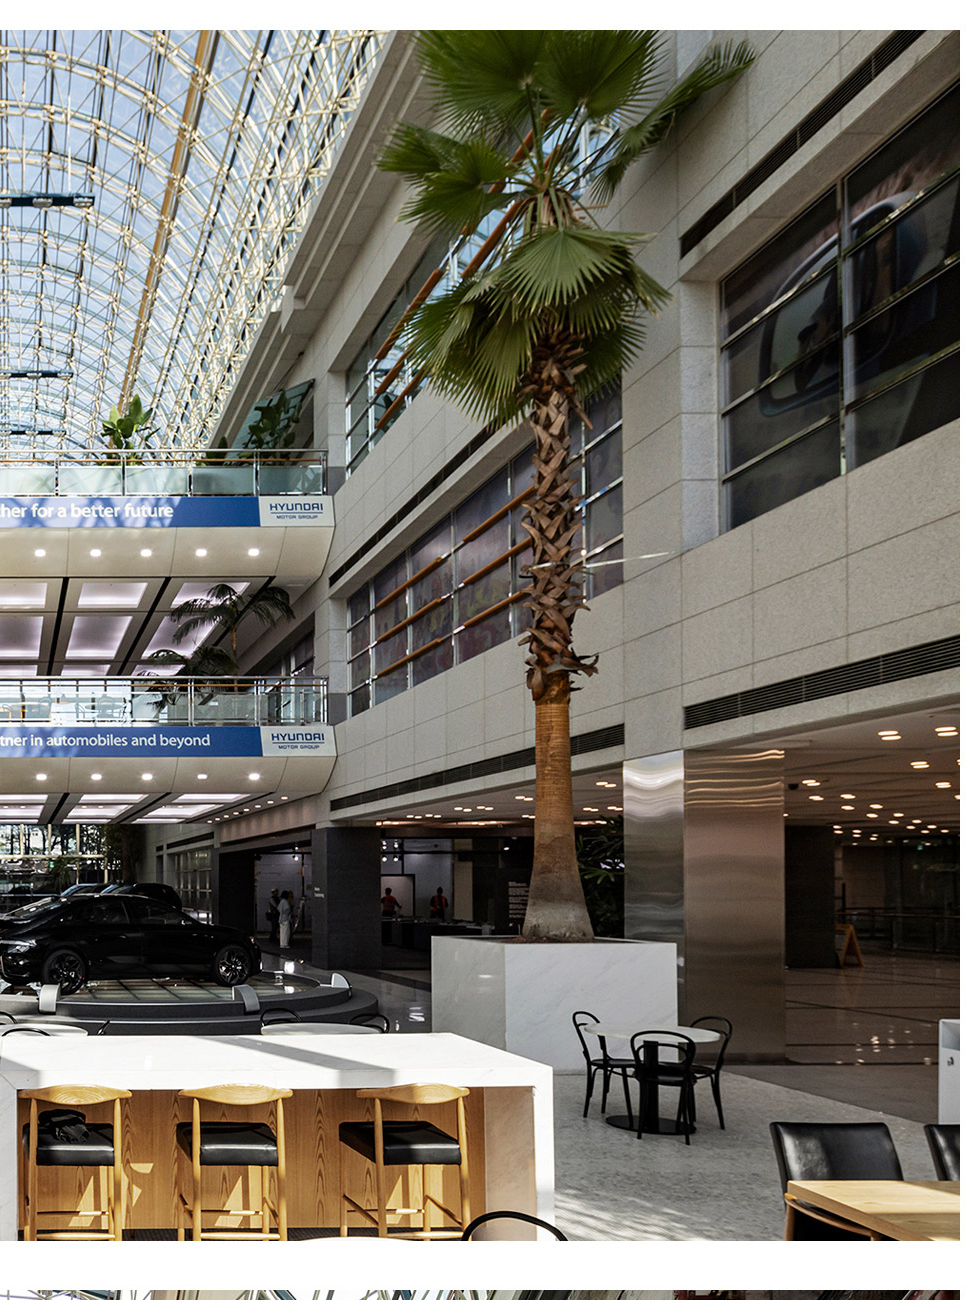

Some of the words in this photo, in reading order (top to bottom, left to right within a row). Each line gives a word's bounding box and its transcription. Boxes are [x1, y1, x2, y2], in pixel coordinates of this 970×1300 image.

[31, 503, 54, 518] for
[57, 508, 67, 518] a
[70, 503, 120, 518] better
[124, 503, 174, 518] future
[270, 503, 324, 511] HYUNDAI
[30, 733, 44, 747] in
[46, 732, 128, 747] automobiles
[131, 732, 157, 747] and
[160, 732, 211, 750] beyond
[271, 733, 325, 741] HYUNDAI
